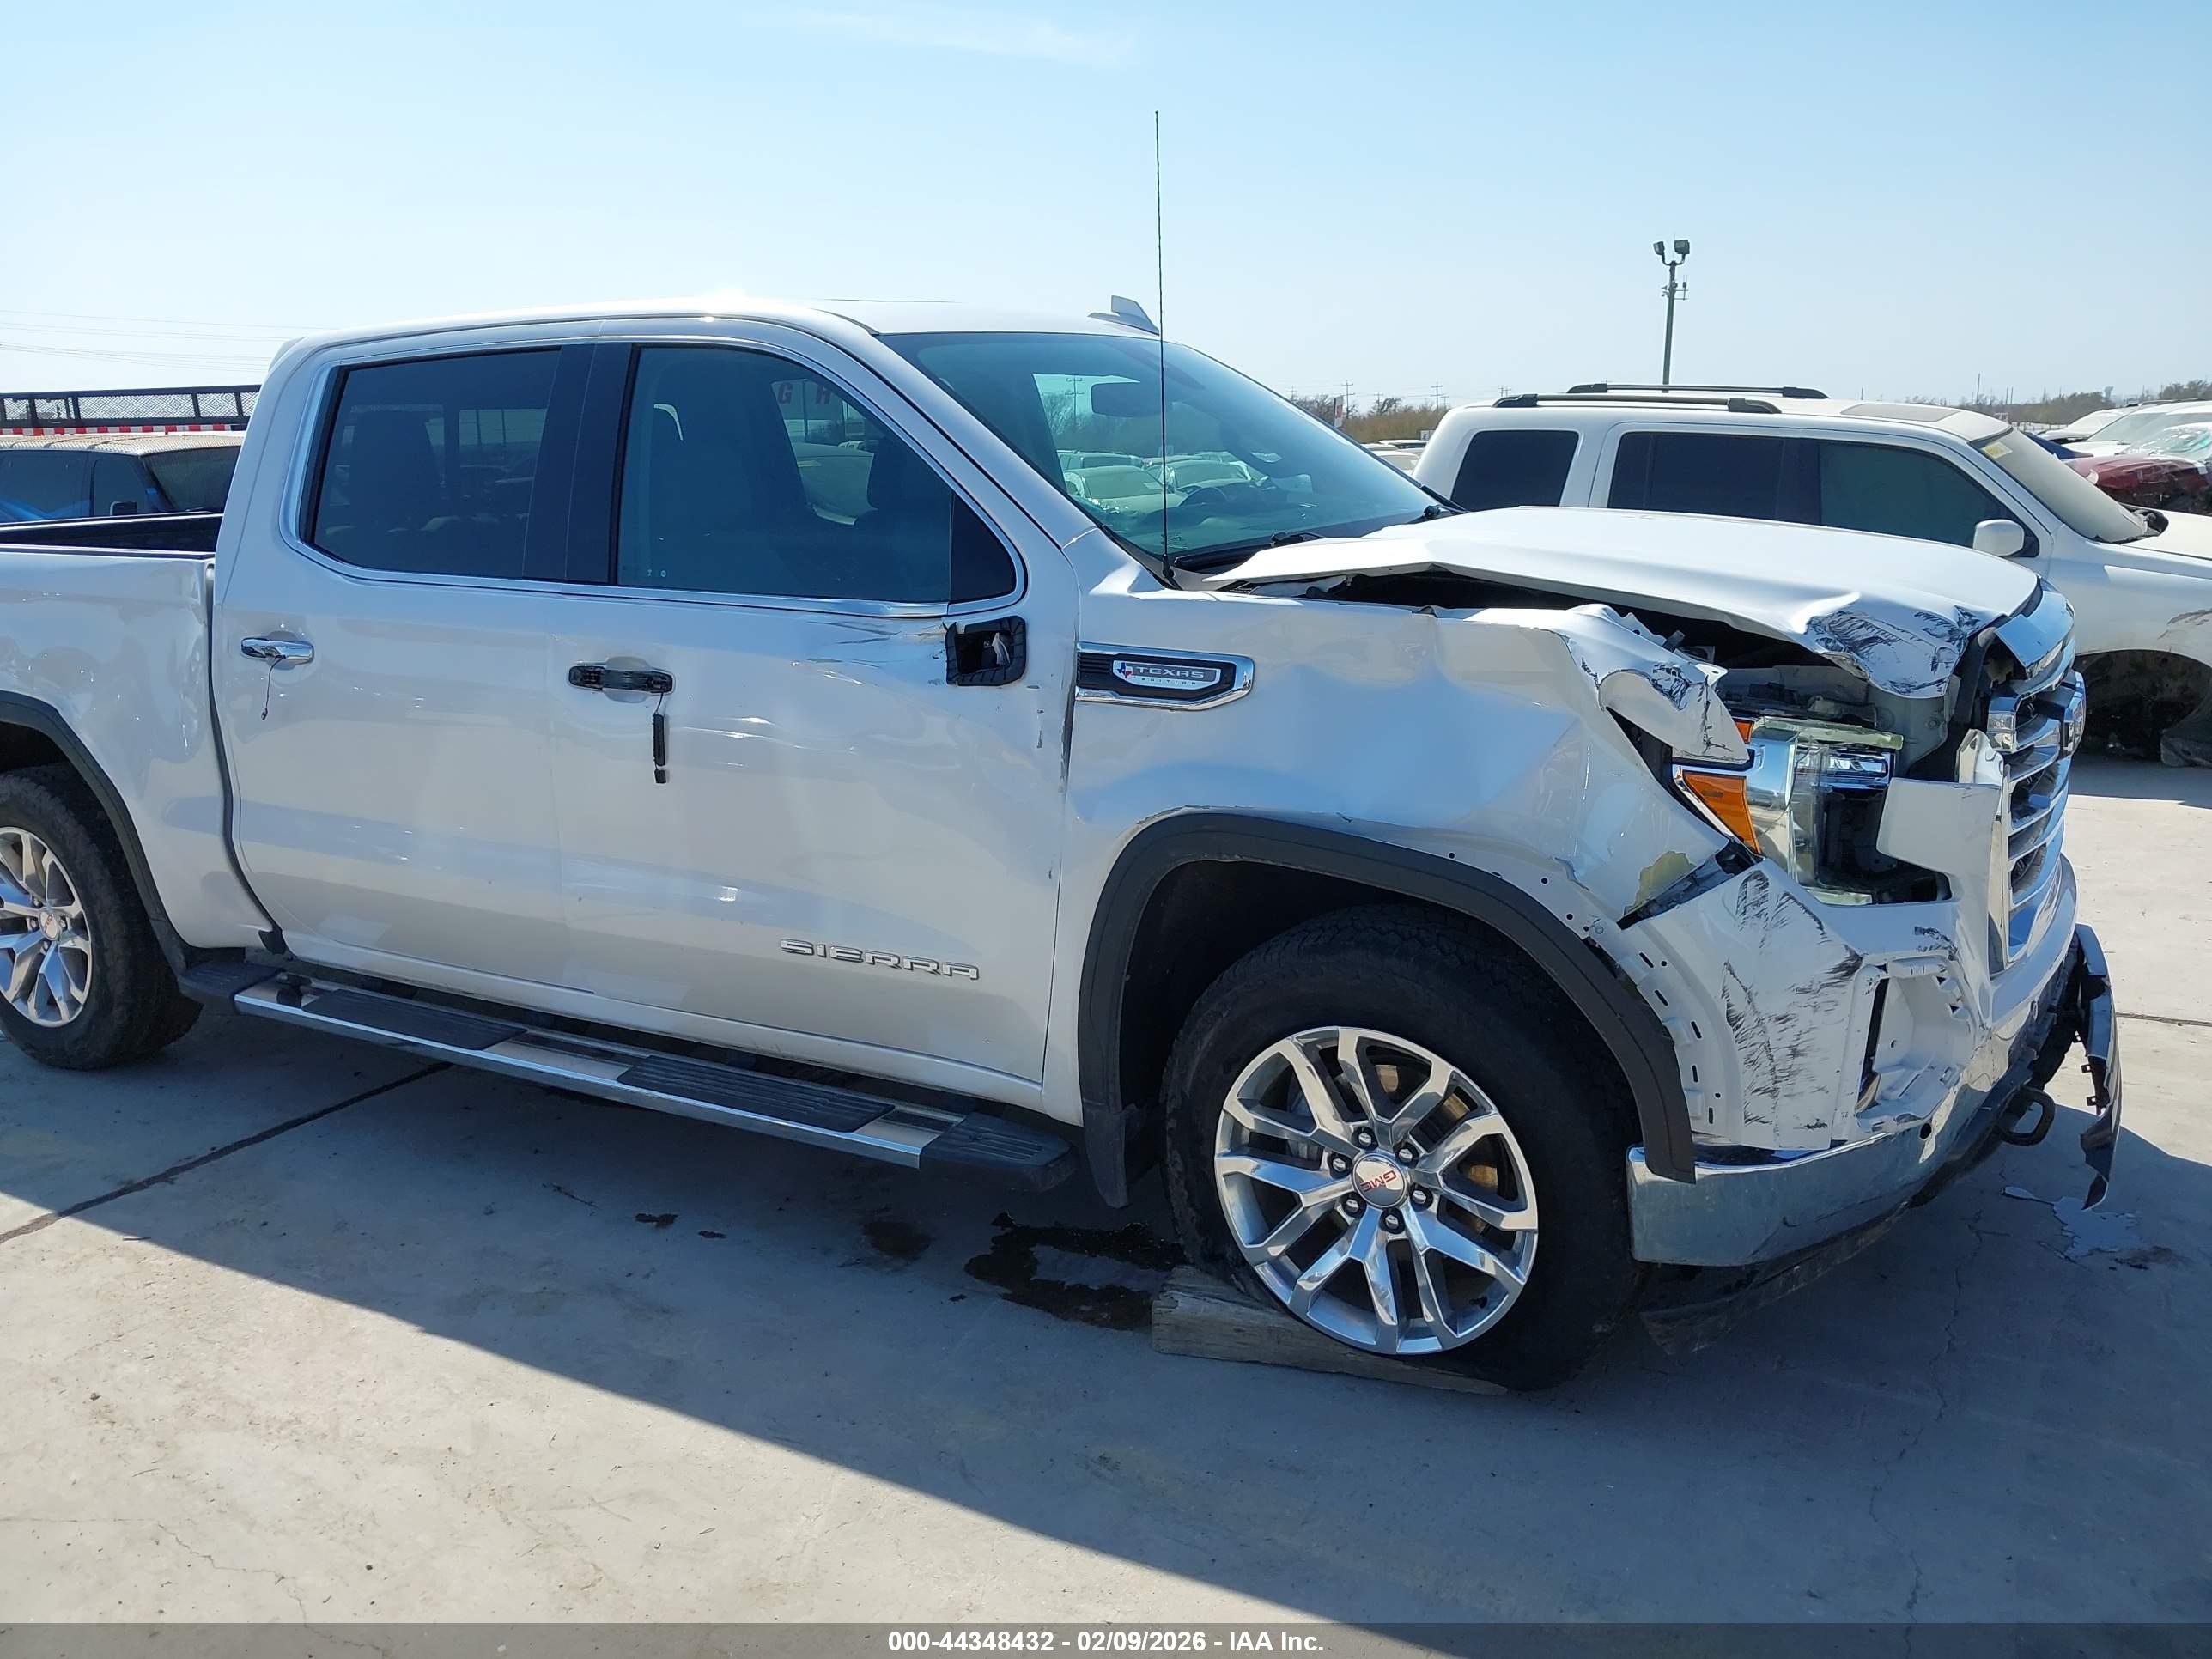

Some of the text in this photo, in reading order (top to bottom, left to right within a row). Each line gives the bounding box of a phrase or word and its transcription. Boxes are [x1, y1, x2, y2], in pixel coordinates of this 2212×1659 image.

[1136, 666, 1205, 678] TEXAS
[780, 938, 979, 980] SIERRA
[1360, 1170, 1397, 1193] GMC
